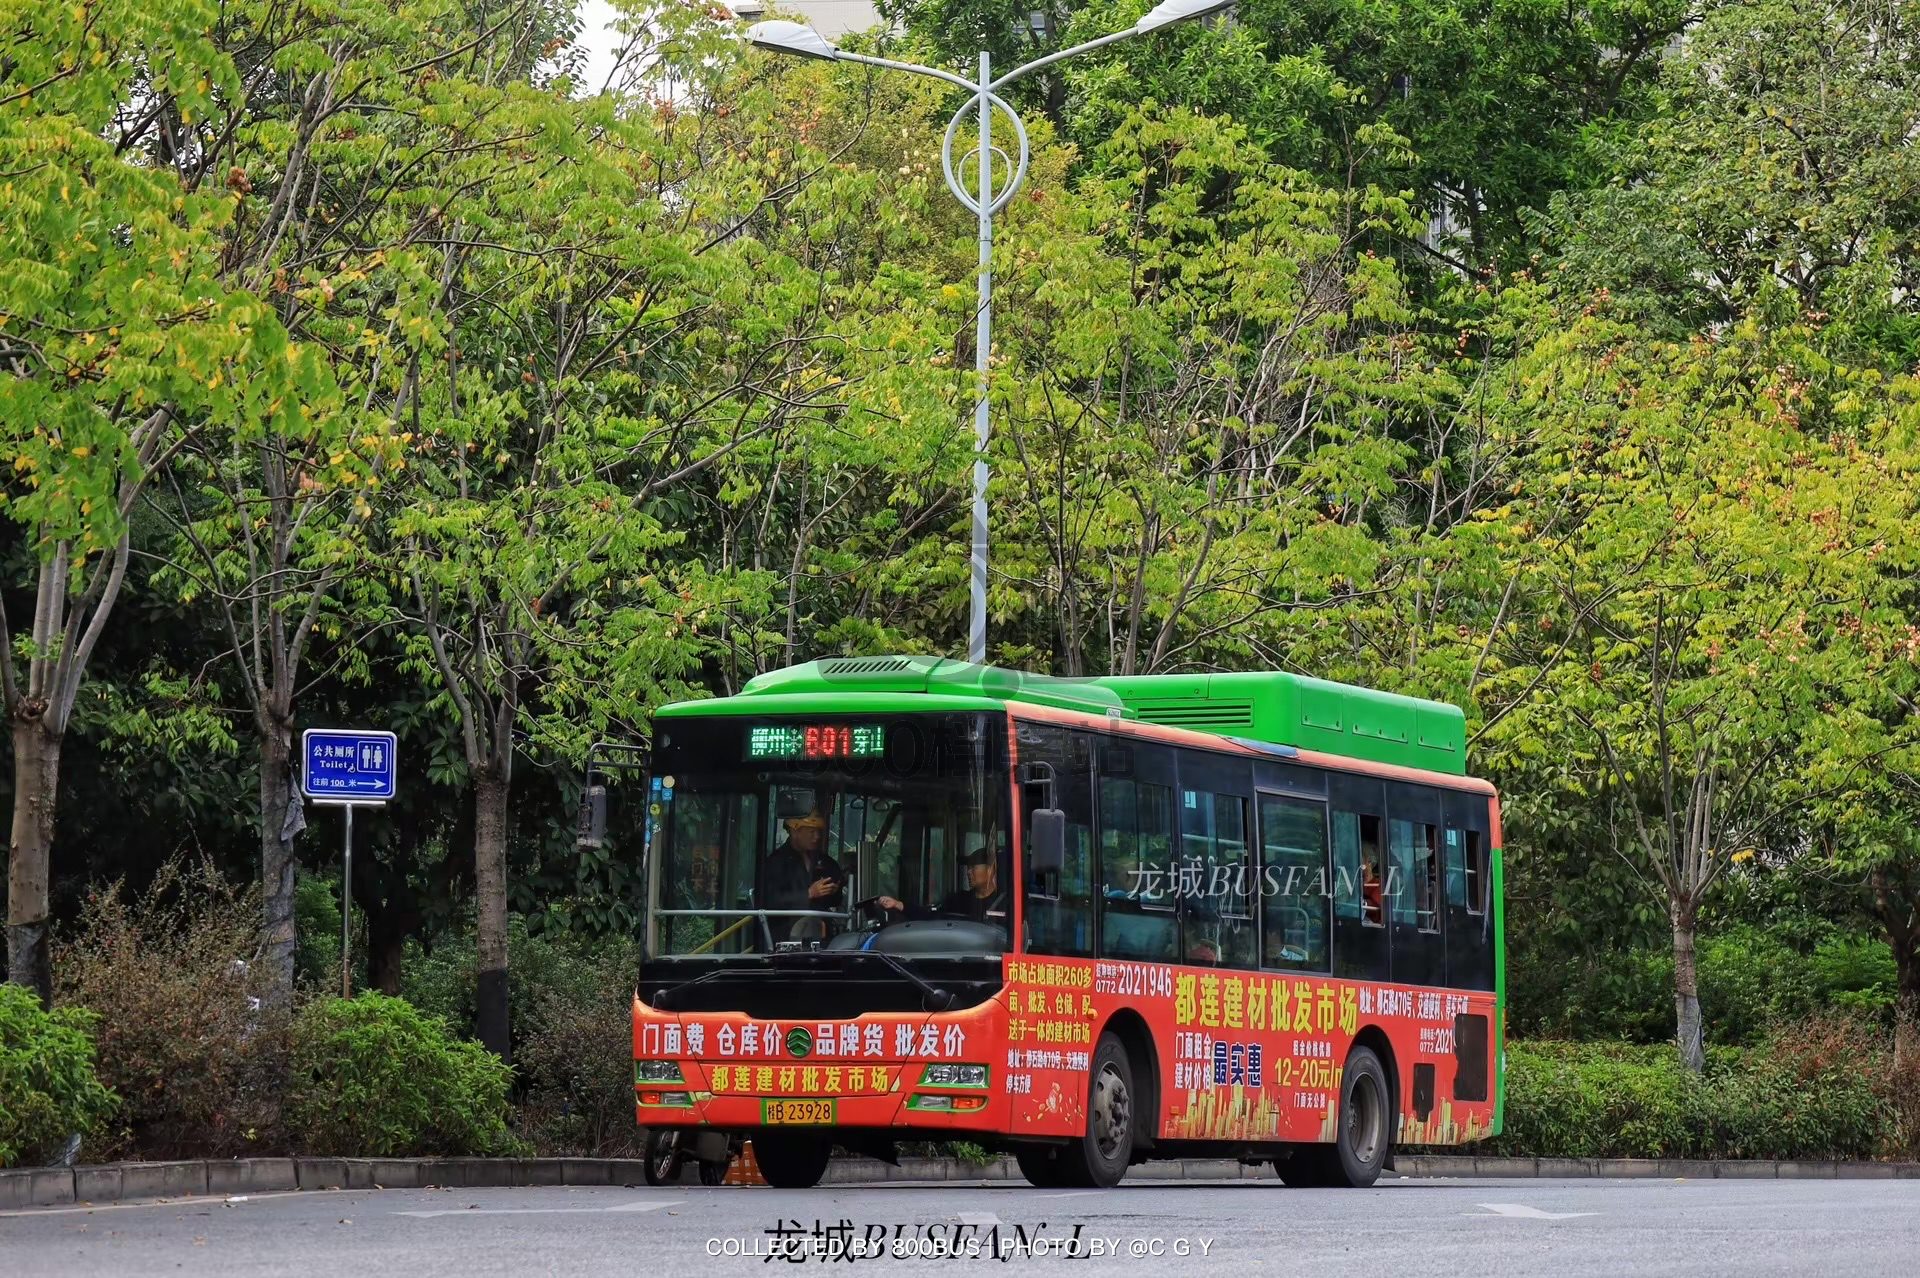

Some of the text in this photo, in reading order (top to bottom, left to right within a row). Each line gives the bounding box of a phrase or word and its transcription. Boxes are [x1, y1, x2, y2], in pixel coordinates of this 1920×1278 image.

[805, 727, 849, 756] 601
[320, 760, 348, 769] Toilet
[312, 777, 357, 787] 往前 100 米
[1008, 962, 1092, 989] 市场占地面积260多
[1095, 979, 1116, 994] 0772
[1118, 964, 1172, 998] 2021946
[1175, 972, 1358, 1037] 都莲建材批发市场
[642, 1022, 966, 1058] 门面费 仓库价 品牌货 批发价
[1007, 1018, 1091, 1044] 送于一体的建材市场
[1435, 1027, 1457, 1054] 2021
[1174, 1031, 1212, 1060] 门面租金
[1293, 1040, 1331, 1057] 租金价格优惠
[1419, 1041, 1434, 1053] 0772
[1174, 1061, 1212, 1091] 建材价格
[1213, 1040, 1262, 1088] 最实惠
[711, 1065, 890, 1093] 都莲建材批发市场
[1005, 1073, 1031, 1095] 停车方便
